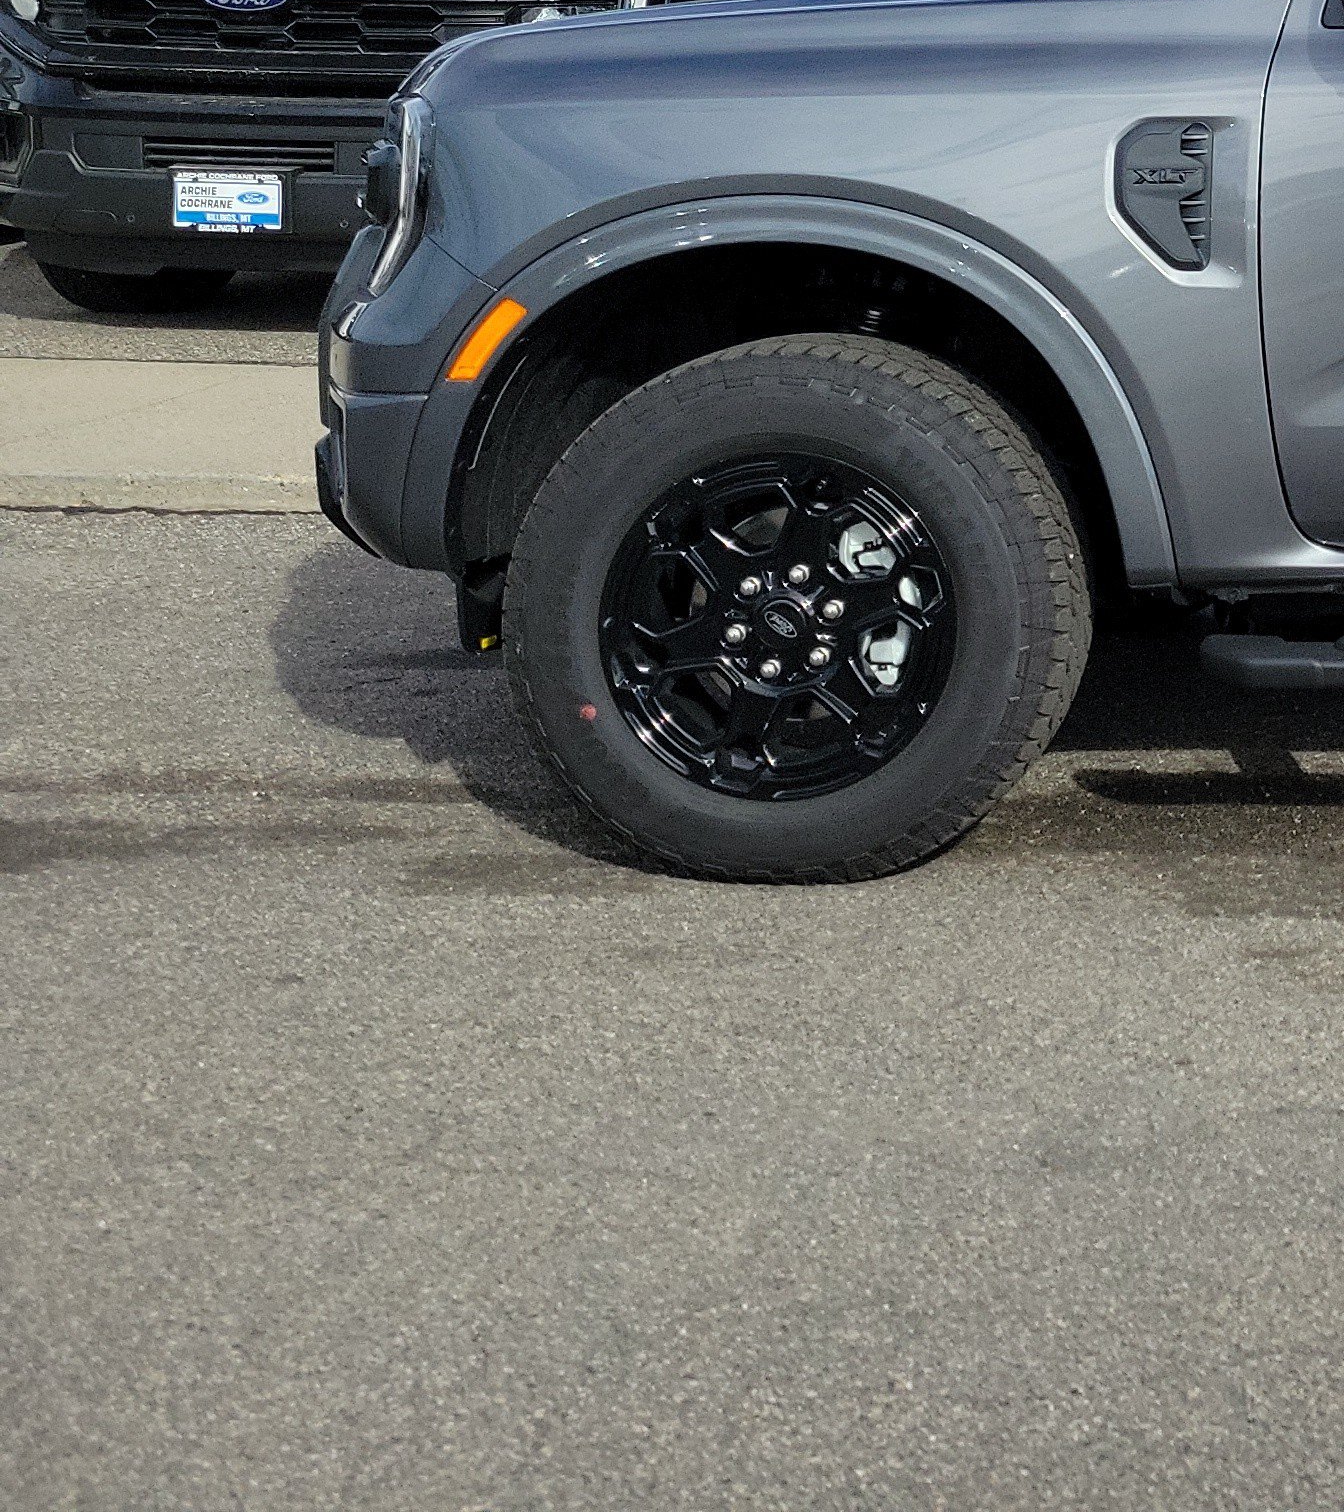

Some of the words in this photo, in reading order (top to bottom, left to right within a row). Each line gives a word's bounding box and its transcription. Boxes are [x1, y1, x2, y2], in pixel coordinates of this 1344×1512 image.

[176, 172, 207, 180] ARCHIE
[1132, 168, 1200, 186] XLT
[180, 186, 218, 196] ARCHIE
[242, 193, 264, 203] Ford
[180, 198, 234, 209] COCHRANE
[240, 214, 252, 223] MT
[198, 224, 239, 233] BILLINGS,
[240, 225, 257, 233] MT
